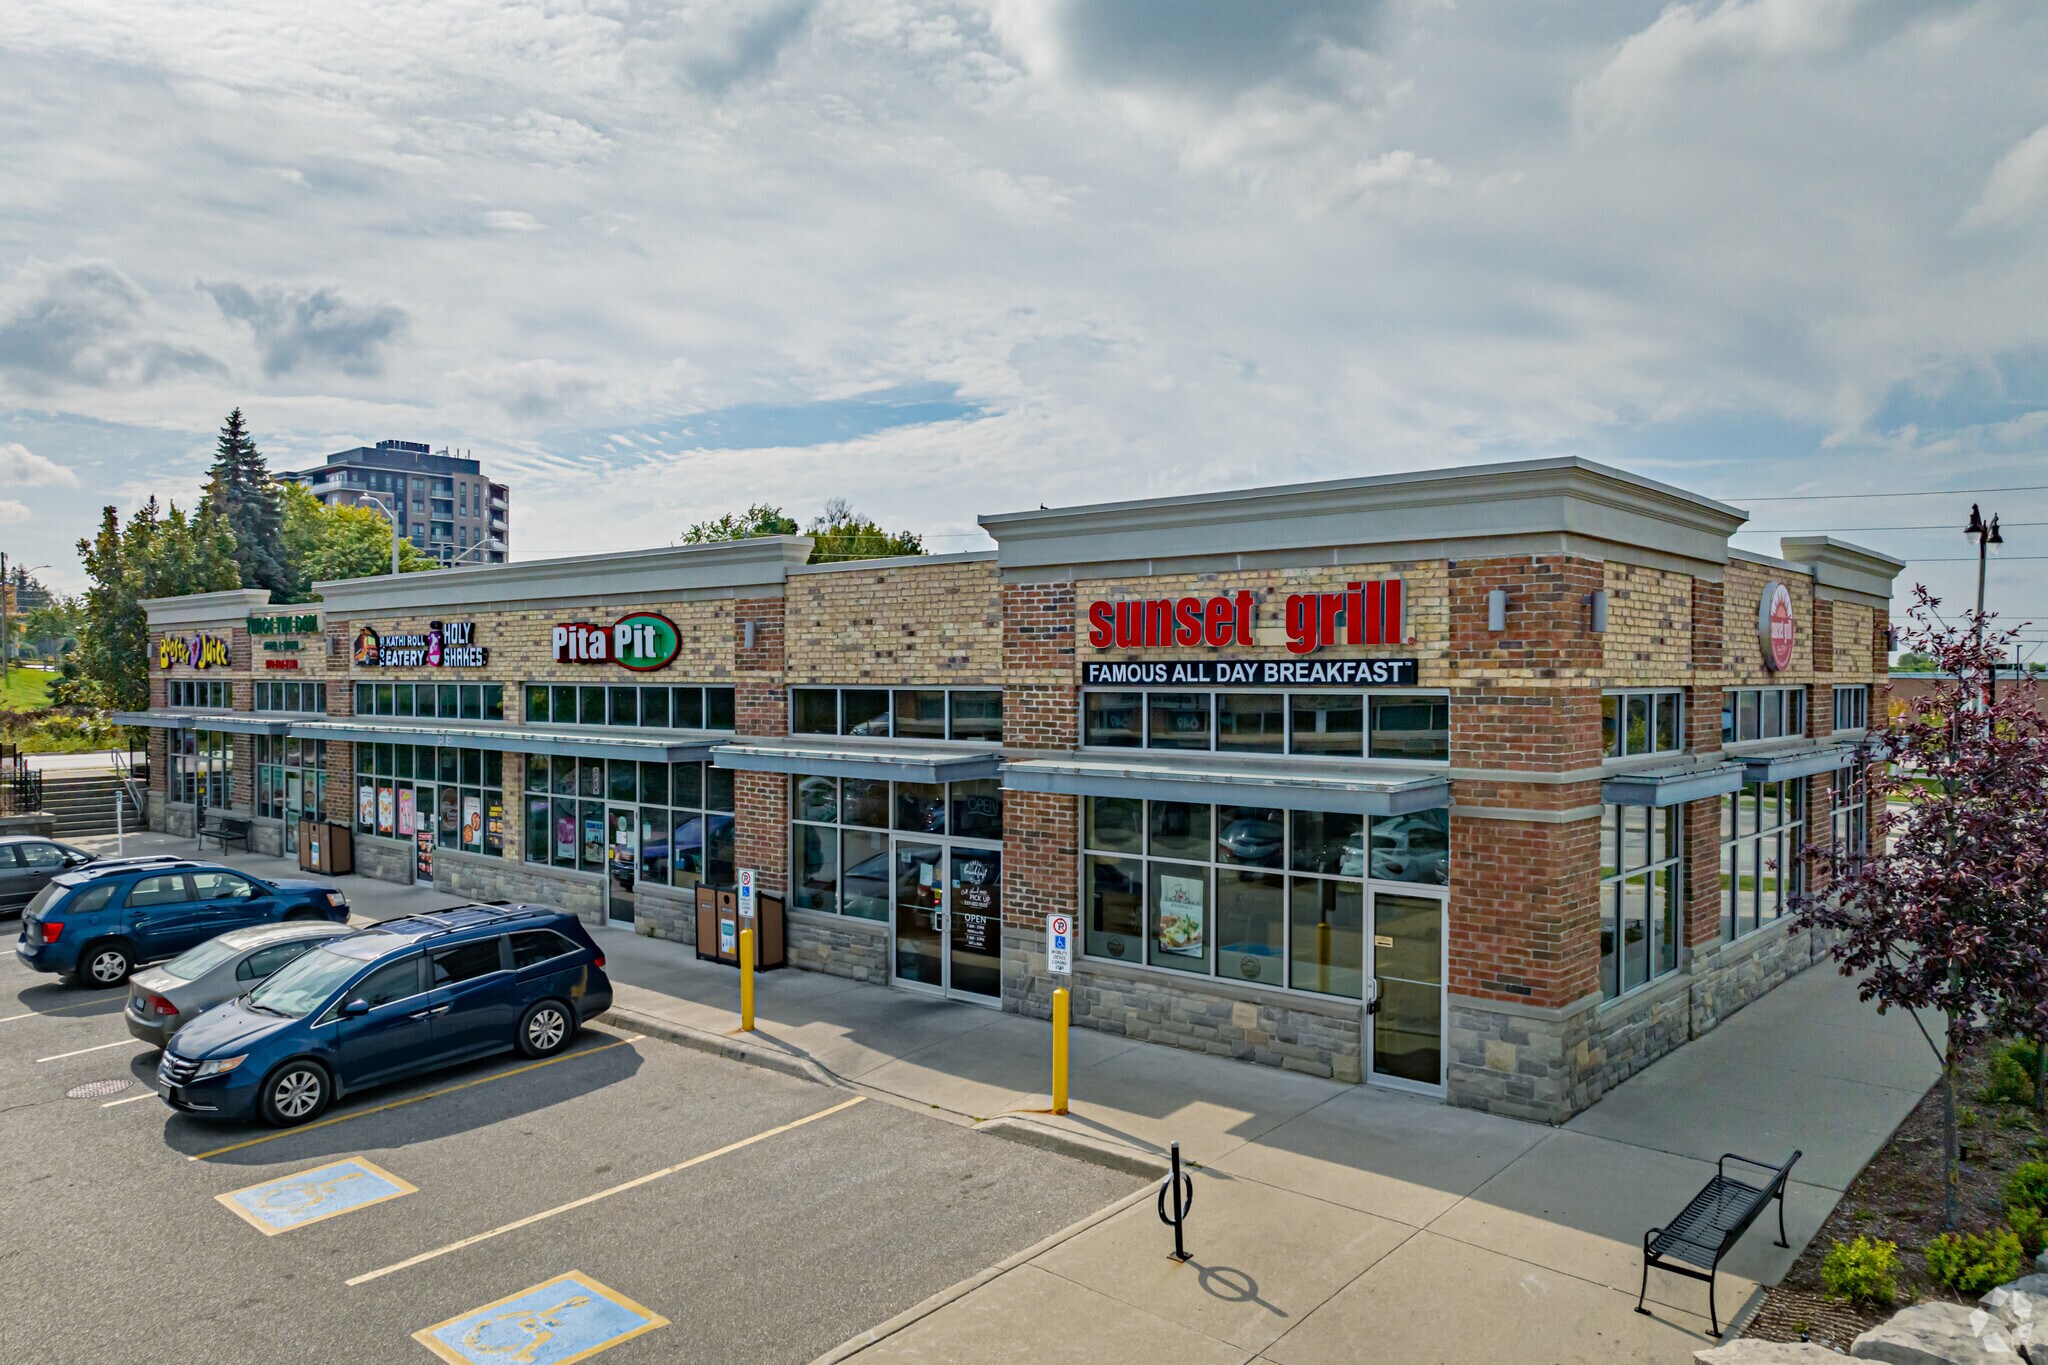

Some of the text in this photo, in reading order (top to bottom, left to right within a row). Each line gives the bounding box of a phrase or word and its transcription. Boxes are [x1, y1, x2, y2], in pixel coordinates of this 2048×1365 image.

[1088, 579, 1402, 654] sunset grill
[386, 634, 425, 647] KATHI ROLL
[443, 622, 471, 645] HOLY
[552, 623, 656, 659] Pita Pit
[160, 633, 228, 669] Booster Juice
[386, 650, 425, 666] EATERY
[1089, 663, 1167, 682] FAMOUS
[1172, 663, 1211, 682] ALL
[1217, 663, 1258, 682] DAY
[964, 913, 986, 924] OPEN
